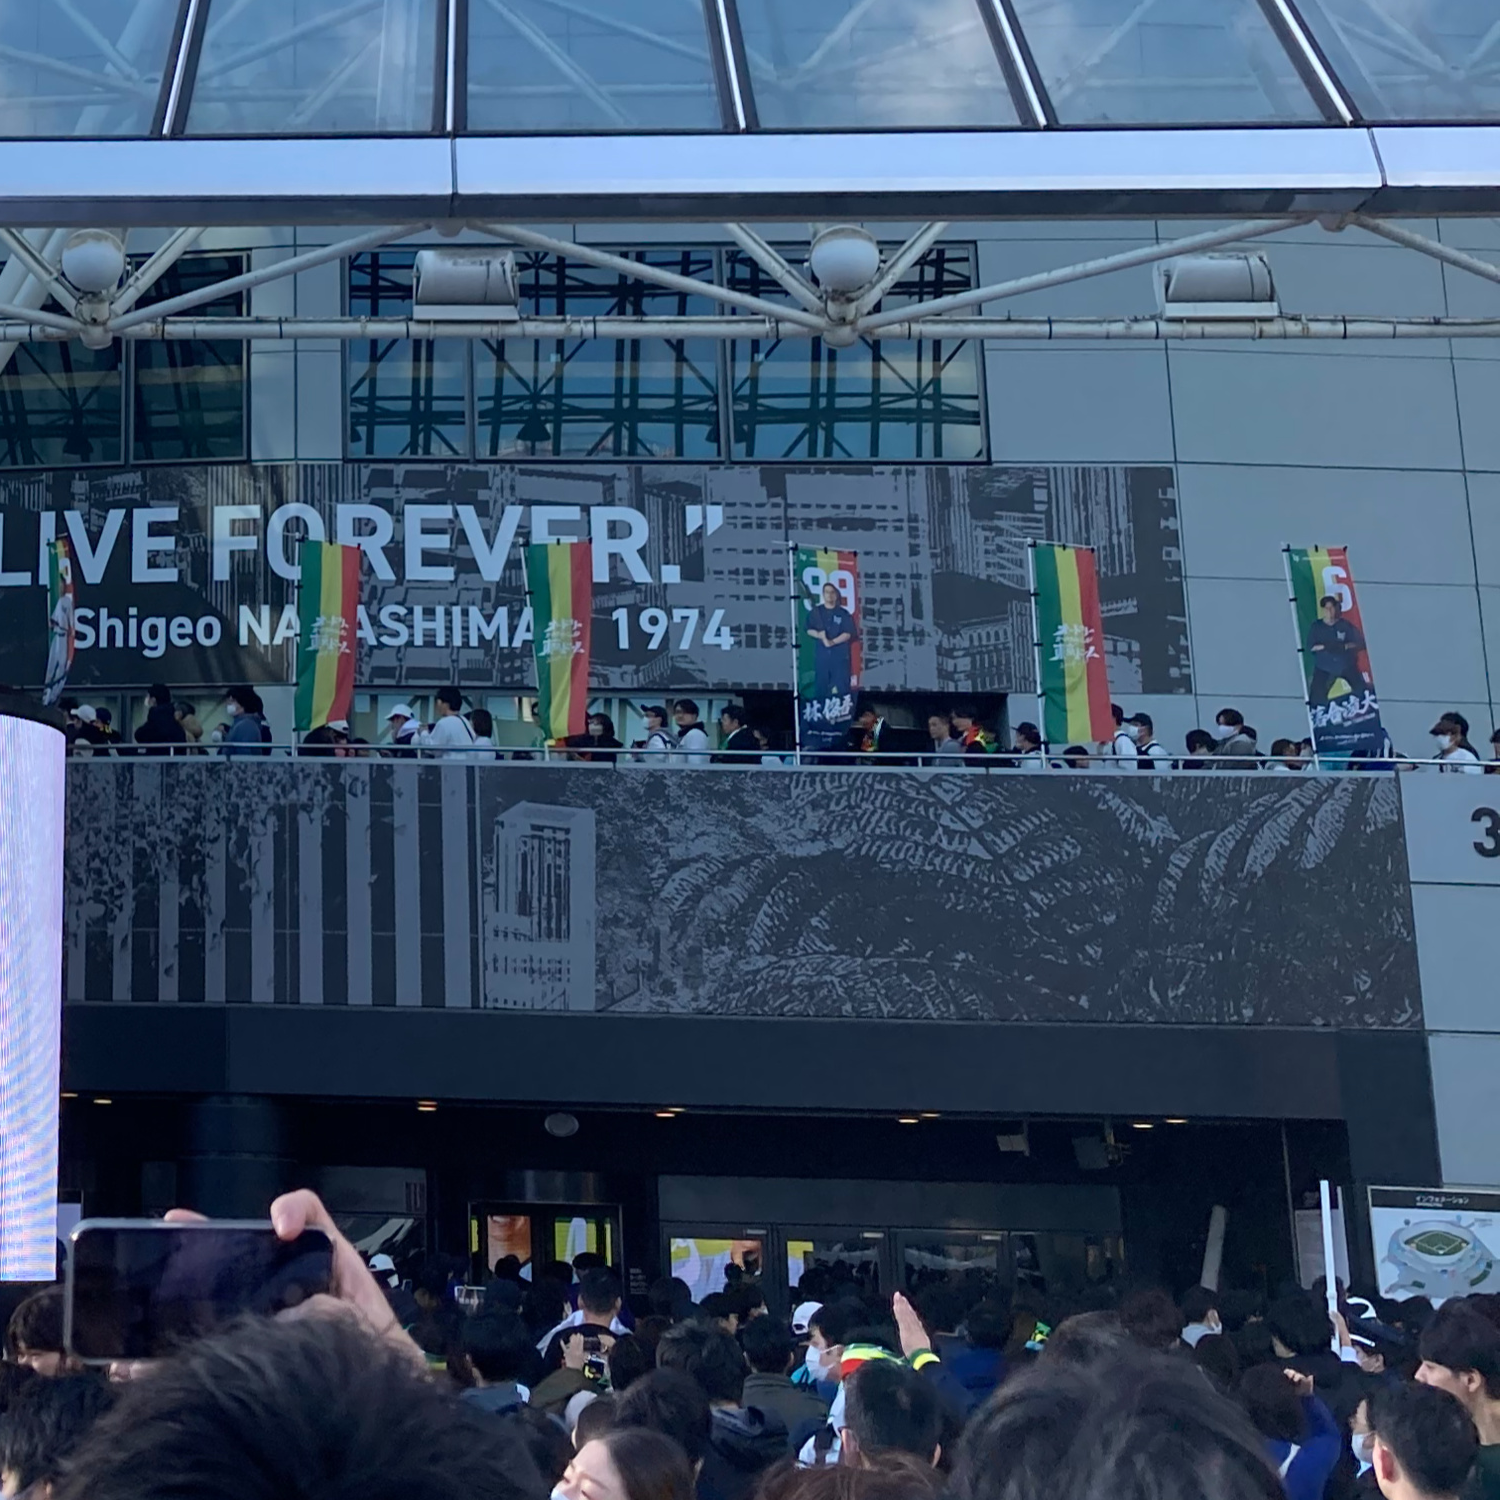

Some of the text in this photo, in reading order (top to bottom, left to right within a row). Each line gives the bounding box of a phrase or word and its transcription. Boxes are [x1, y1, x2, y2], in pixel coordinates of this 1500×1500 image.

[74, 607, 222, 658] Shigeo
[239, 604, 534, 648] NAASHIMA
[612, 607, 735, 650] 1974
